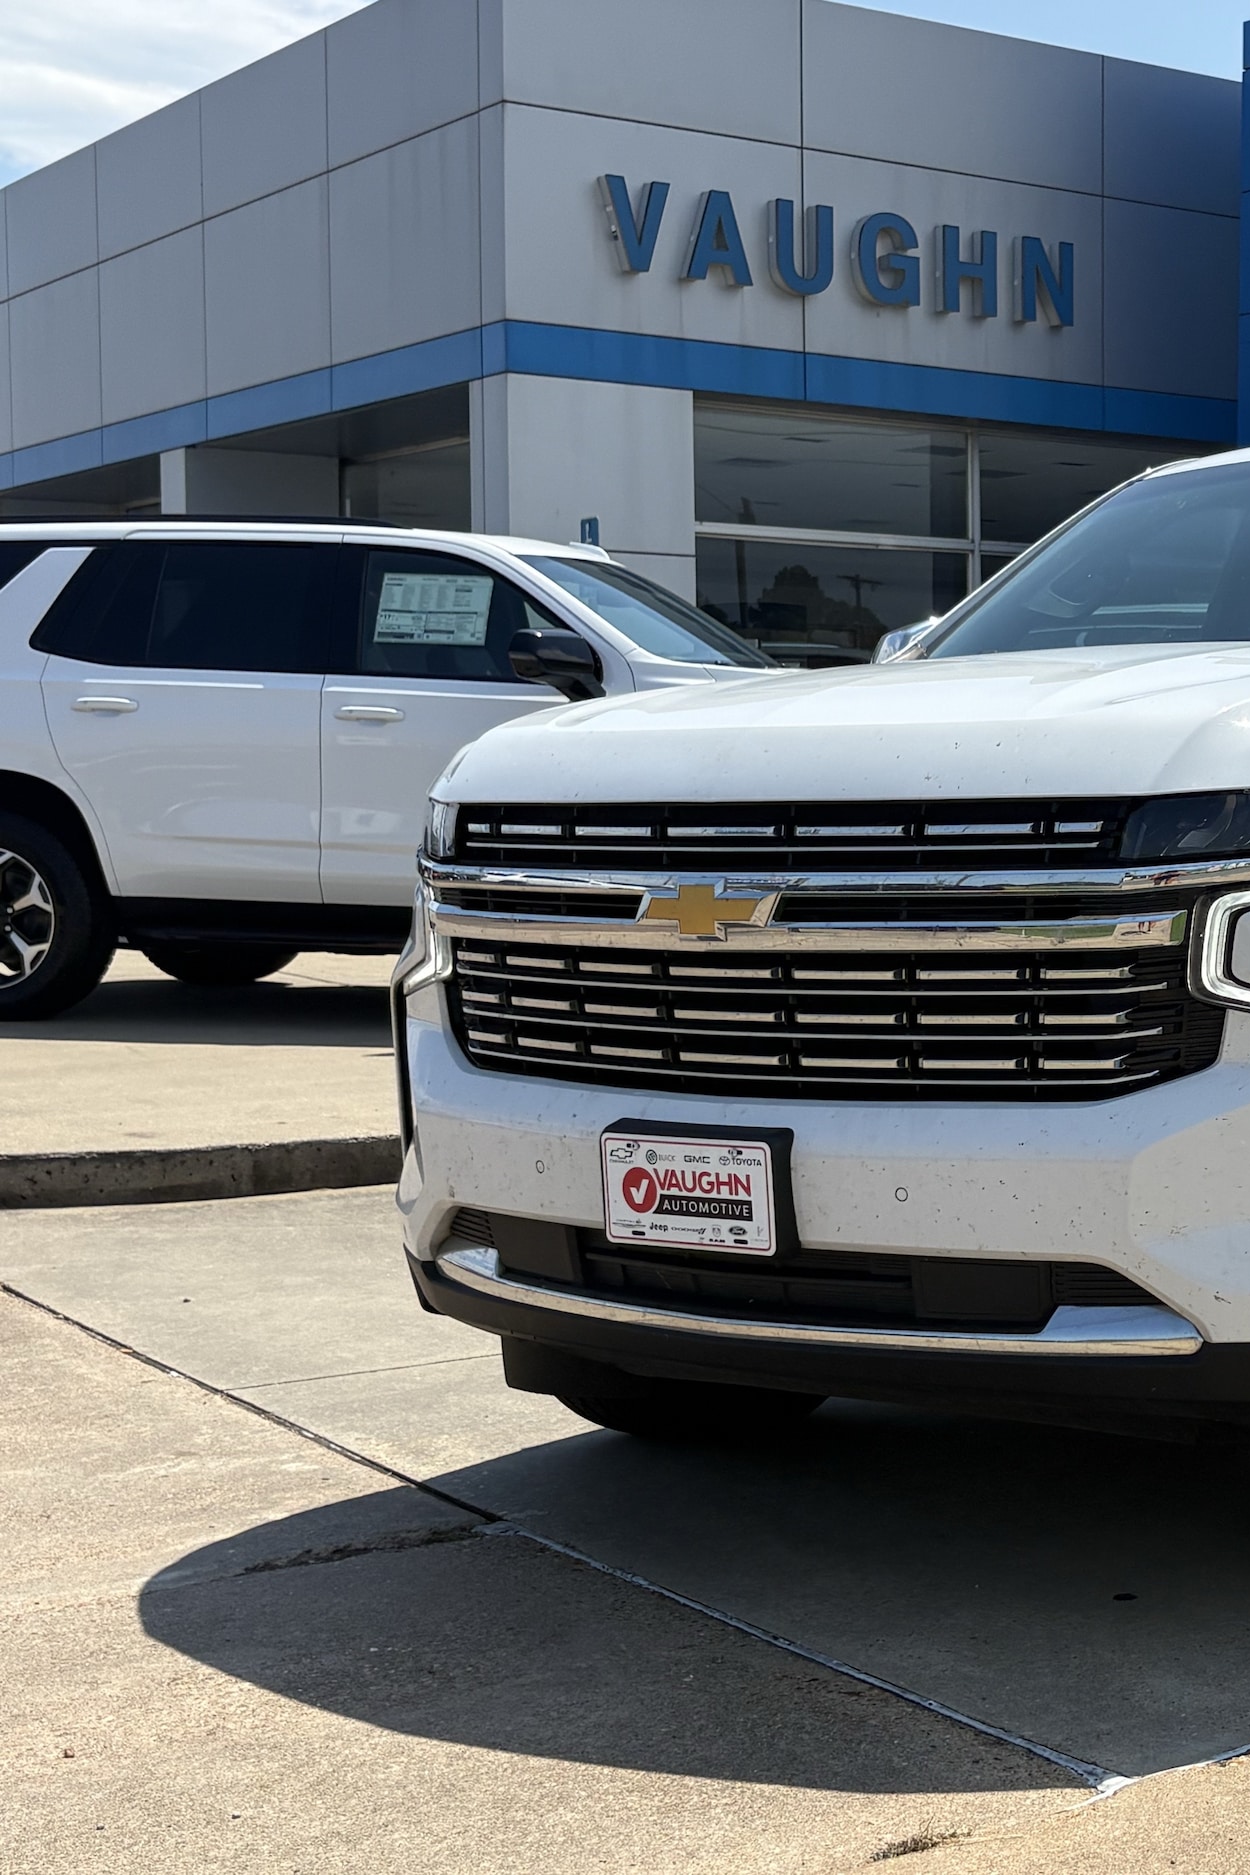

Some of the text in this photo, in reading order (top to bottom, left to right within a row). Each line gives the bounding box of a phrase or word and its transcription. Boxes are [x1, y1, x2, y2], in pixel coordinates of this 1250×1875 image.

[599, 173, 1075, 328] VAUGHN
[659, 1154, 676, 1162] BUICK
[684, 1155, 711, 1164] GMC
[732, 1157, 762, 1167] TOYOTA
[653, 1168, 752, 1197] VAUGHN
[662, 1199, 750, 1217] AUTOMOTIVE
[649, 1222, 669, 1233] Jeep
